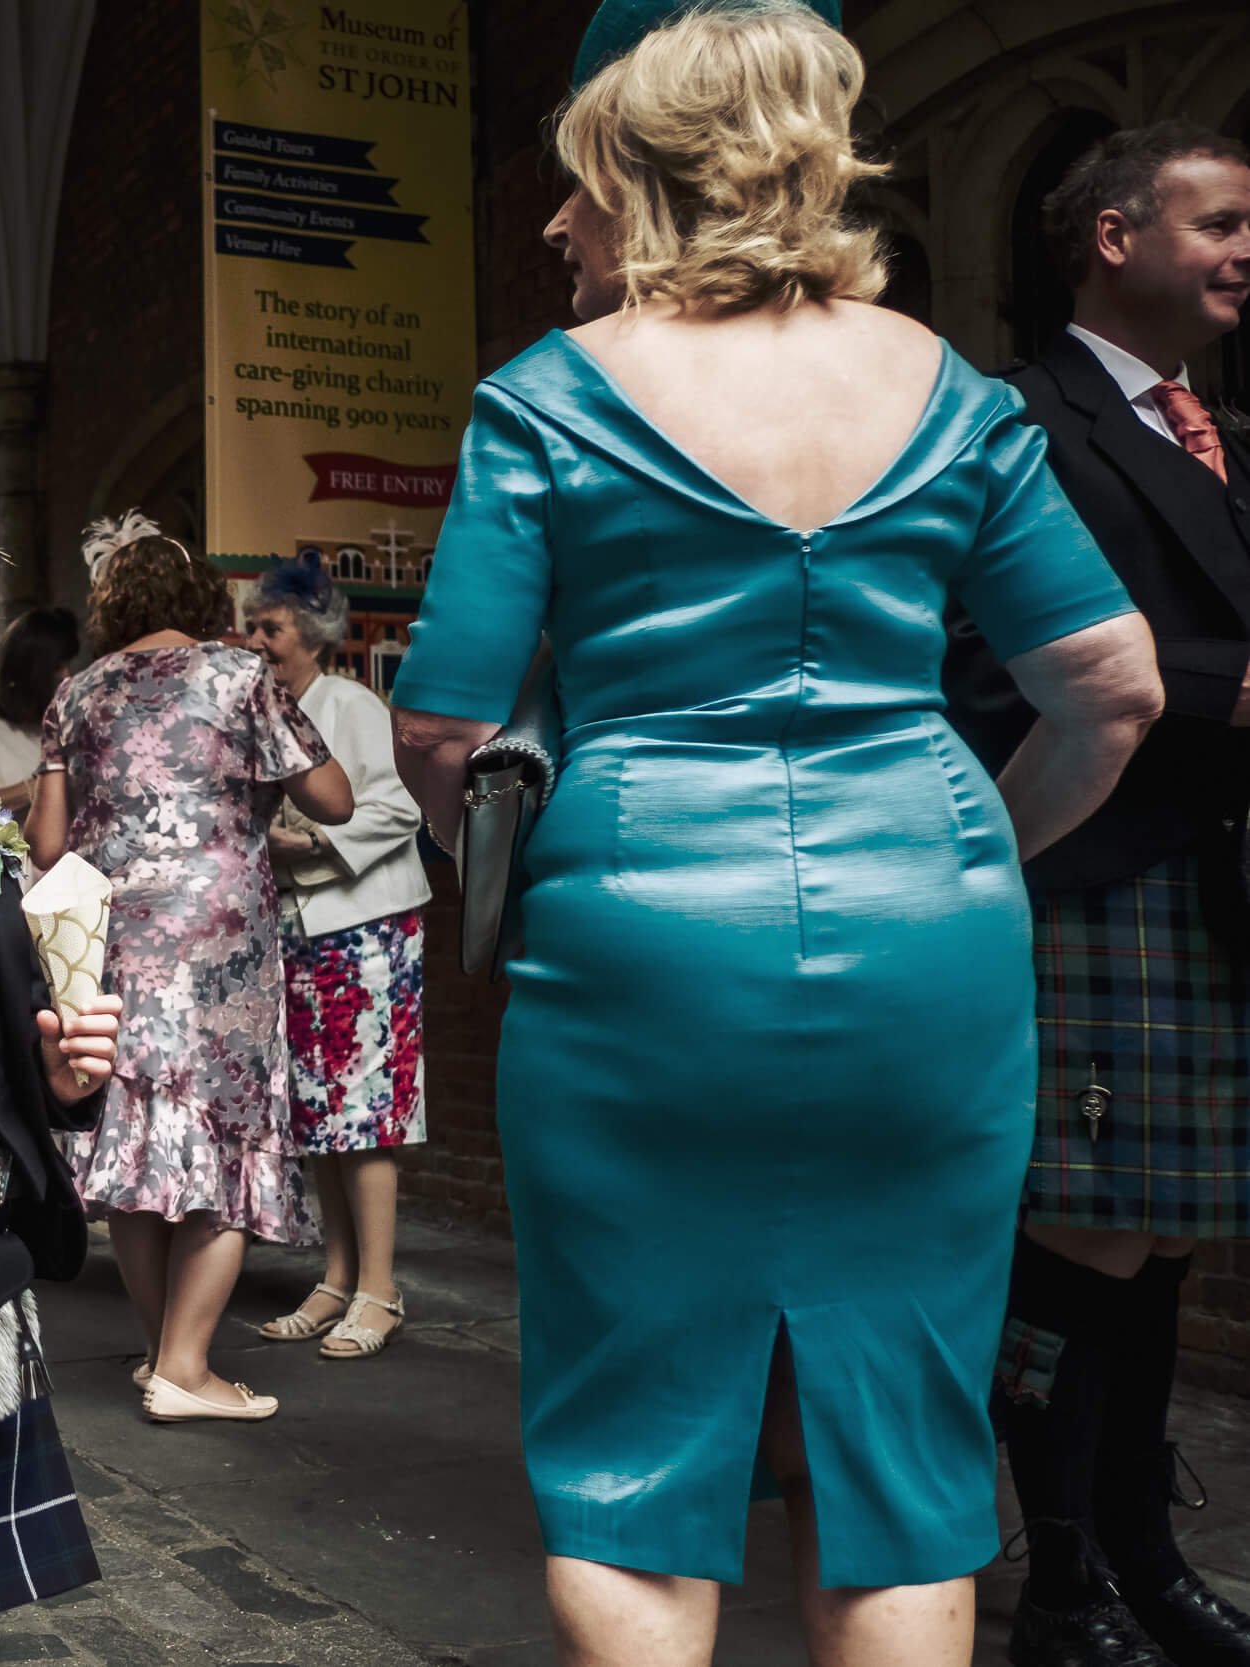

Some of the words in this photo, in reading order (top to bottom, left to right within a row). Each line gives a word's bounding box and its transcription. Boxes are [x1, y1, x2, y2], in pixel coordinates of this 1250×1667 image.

[319, 7, 425, 47] Museum
[433, 26, 460, 50] of
[320, 41, 359, 60] THE
[365, 47, 431, 71] ORDER
[435, 56, 460, 75] OF
[318, 64, 359, 93] ST
[363, 72, 458, 108] JOHN
[222, 130, 272, 152] Guided
[275, 138, 315, 157] Tours
[223, 164, 271, 188] Family
[272, 173, 339, 194] Activities
[223, 200, 307, 227] Community
[309, 211, 355, 230] Events
[224, 234, 270, 254] Venue
[271, 239, 302, 257] Hire
[255, 289, 299, 317] The
[305, 299, 360, 329] story
[365, 303, 390, 326] of
[393, 311, 421, 329] an
[265, 326, 411, 361] international
[235, 362, 360, 396] care-giving
[366, 369, 444, 402] charity
[236, 395, 340, 428] spanning
[346, 407, 388, 429] 900
[394, 411, 450, 434] years
[330, 471, 377, 492] FREE
[383, 477, 447, 497] ENTRY
